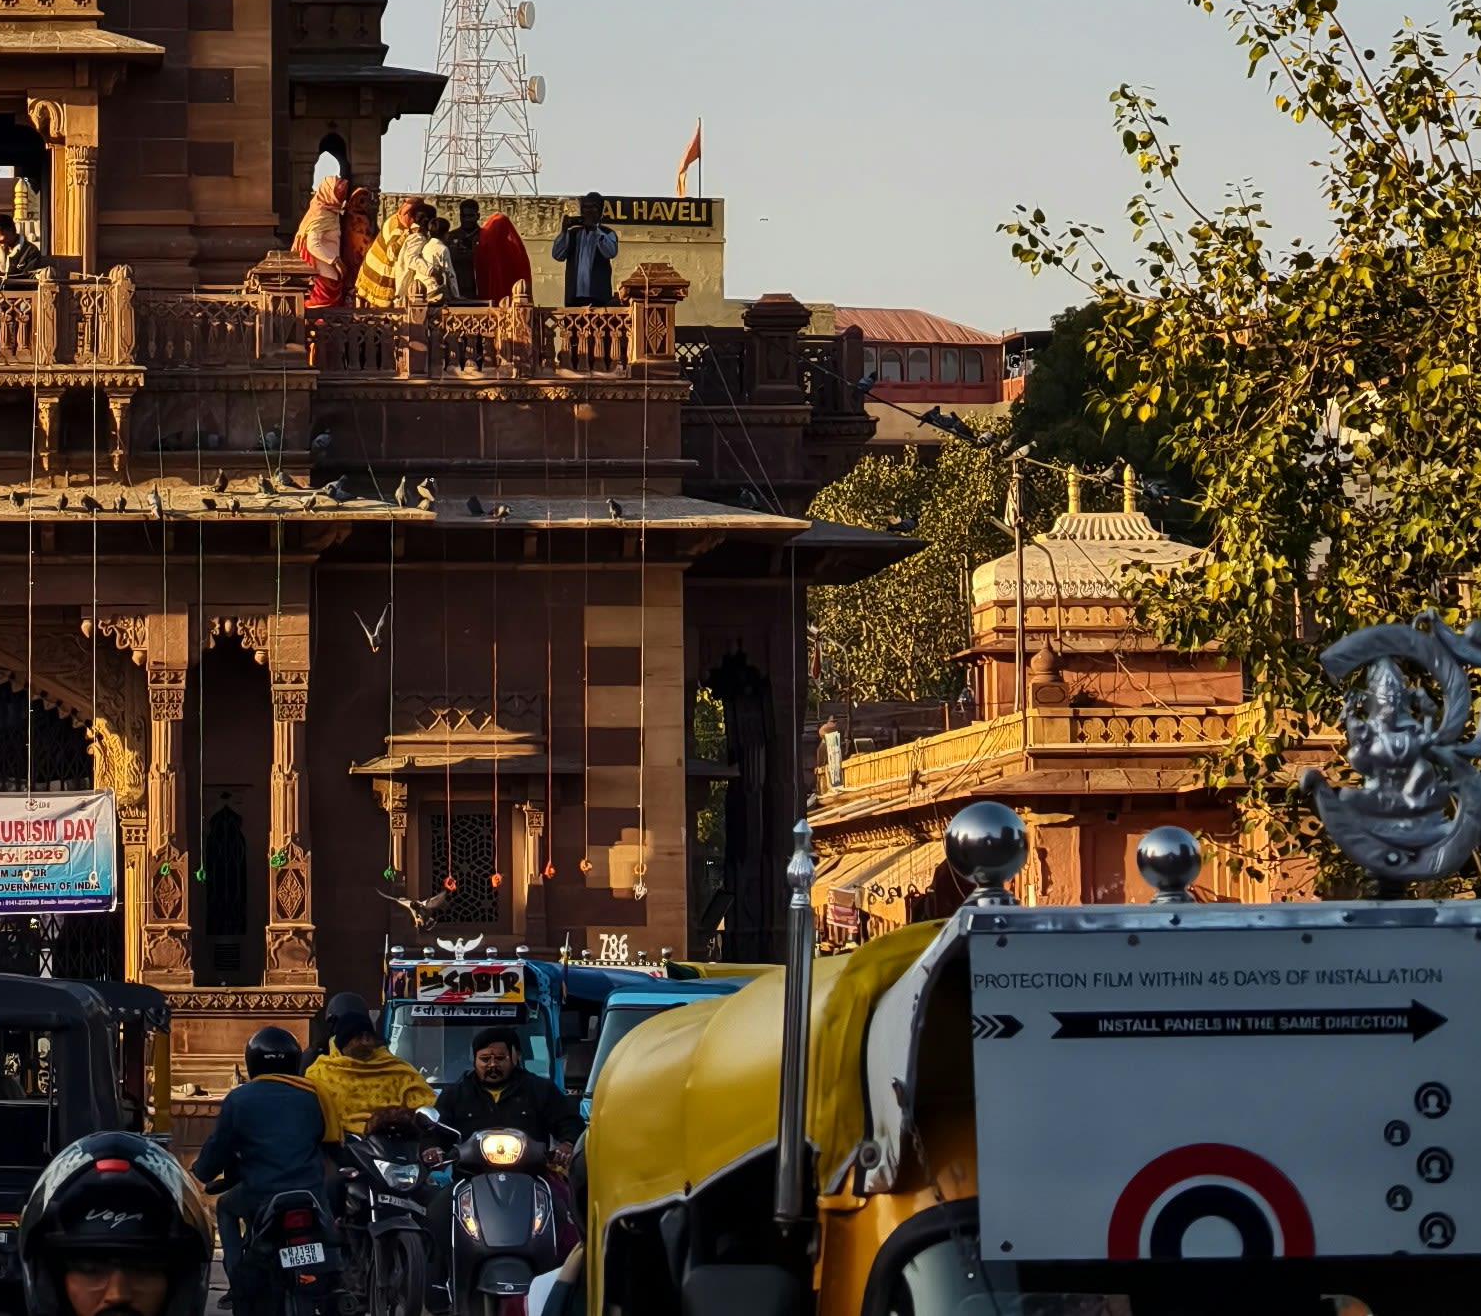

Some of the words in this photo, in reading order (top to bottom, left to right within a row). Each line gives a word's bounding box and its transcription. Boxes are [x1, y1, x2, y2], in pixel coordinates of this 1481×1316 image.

[602, 200, 628, 220] AL
[633, 200, 707, 221] HAVELI
[63, 818, 96, 841] DAY
[10, 868, 47, 878] JAUR
[59, 881, 72, 891] OF
[599, 933, 629, 961] 786
[973, 972, 1087, 989] PROTECTION
[1093, 972, 1133, 988] FILM
[1138, 971, 1203, 987] WITHIN
[1208, 971, 1229, 986] 45
[1233, 970, 1281, 986] DAYS
[1286, 969, 1310, 985] OF
[1316, 968, 1443, 985] INSTALLATION
[1097, 1018, 1162, 1032] INSTALL
[1164, 1017, 1223, 1031] PANELS
[1225, 1017, 1242, 1030] IN
[1245, 1017, 1276, 1031] THE
[1279, 1016, 1321, 1031] SAME
[1325, 1014, 1409, 1030] DIRECTION
